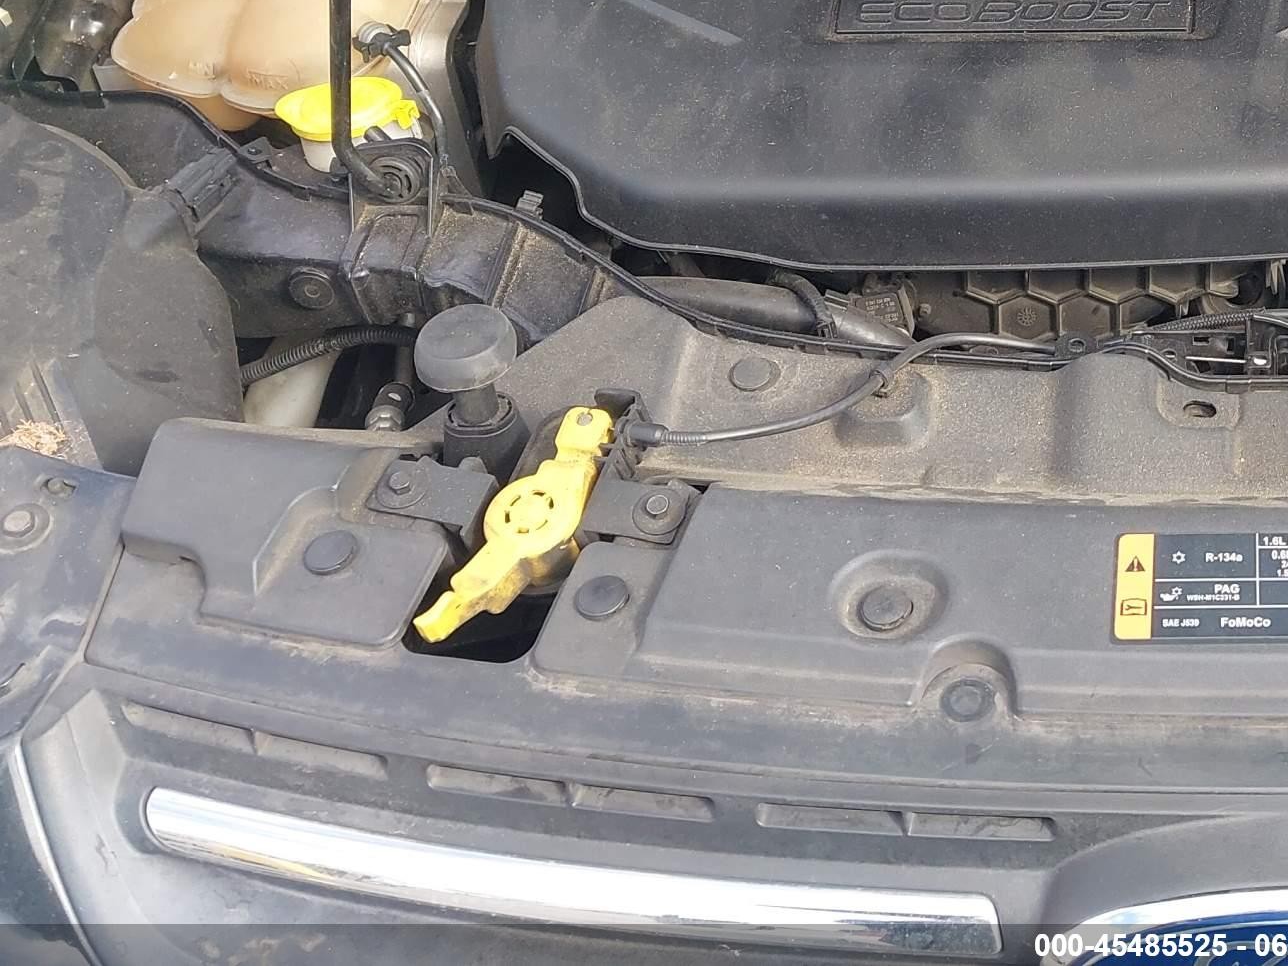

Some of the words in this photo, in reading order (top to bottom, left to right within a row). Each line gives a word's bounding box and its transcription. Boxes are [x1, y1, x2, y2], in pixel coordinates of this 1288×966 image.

[247, 73, 289, 91] MAX
[1263, 536, 1286, 546] 1.6L
[1205, 552, 1243, 563] R-134a
[1214, 584, 1241, 594] PAG
[1162, 618, 1180, 627] SAE
[1221, 617, 1272, 627] FoMoCo
